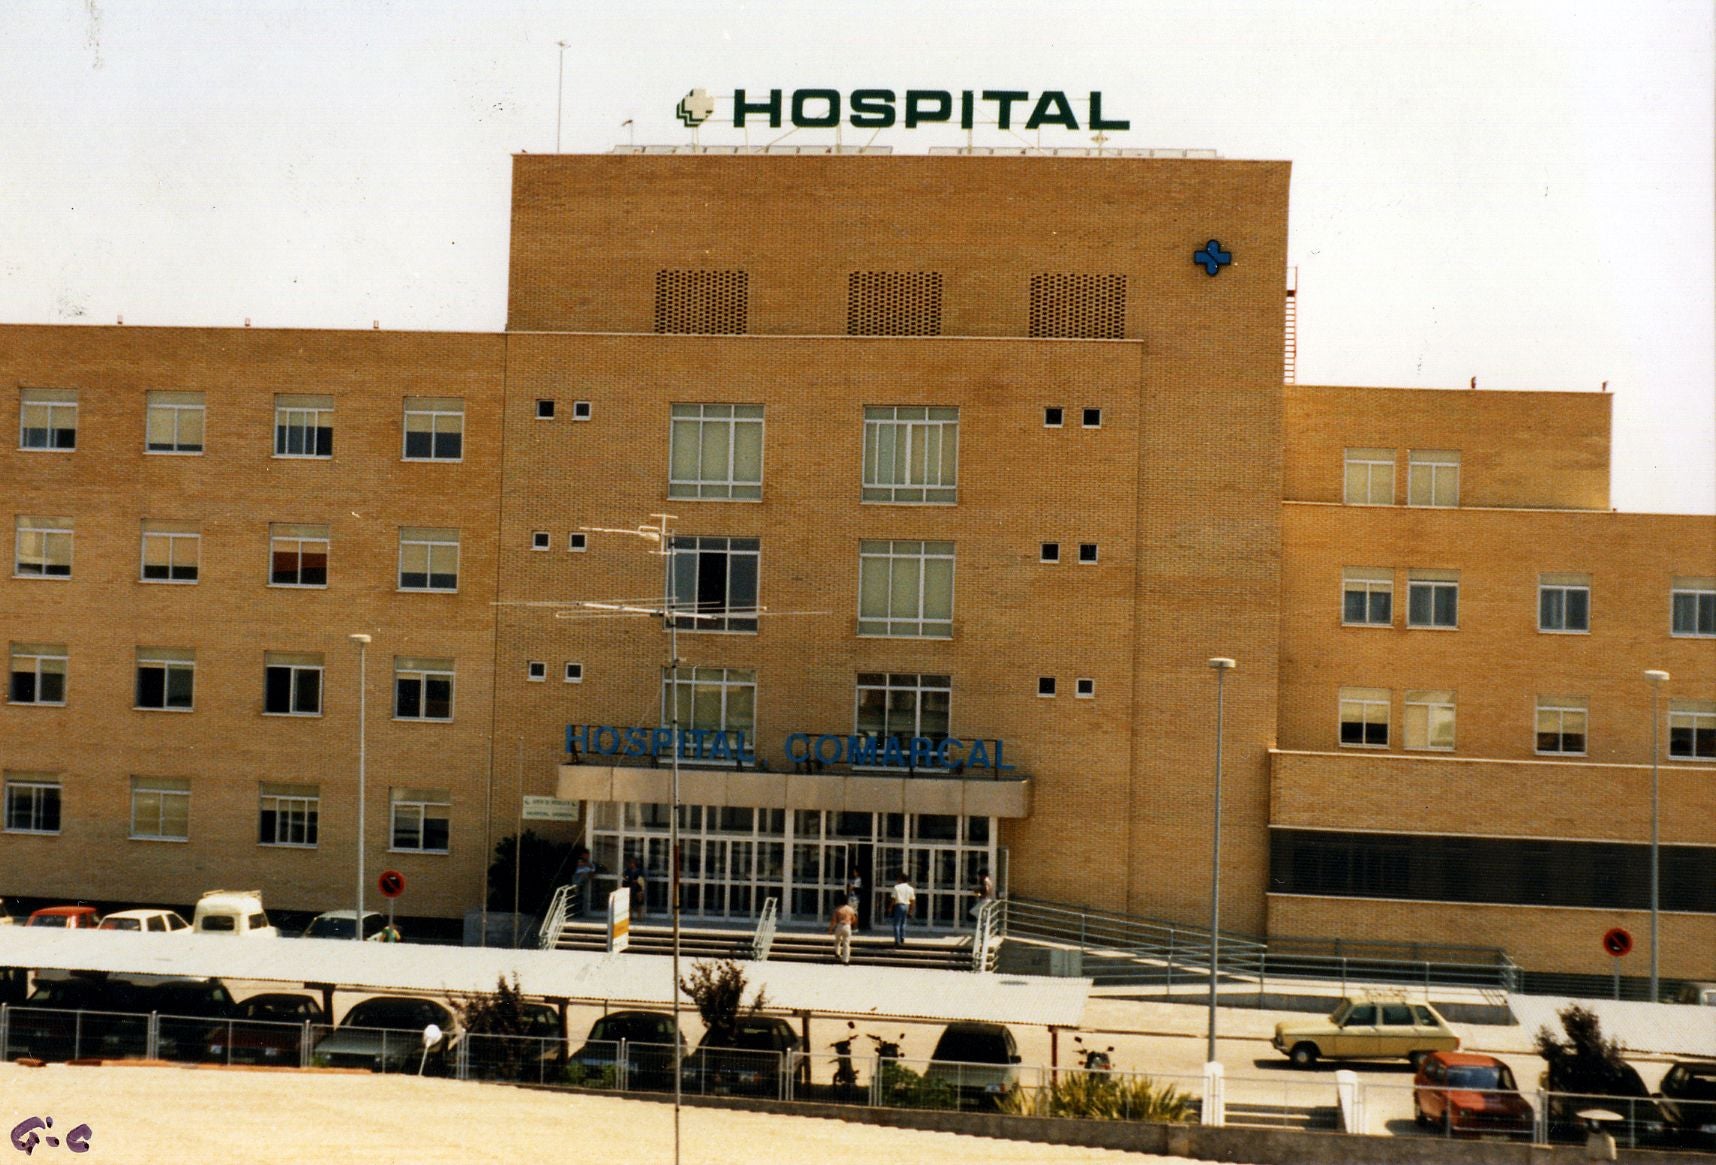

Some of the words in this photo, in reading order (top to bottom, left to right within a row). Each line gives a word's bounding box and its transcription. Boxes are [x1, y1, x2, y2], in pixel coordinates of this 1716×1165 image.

[733, 88, 1130, 131] HOSPITAL
[565, 724, 756, 763] HOSPITAL
[784, 732, 1016, 771] COMARCAL
